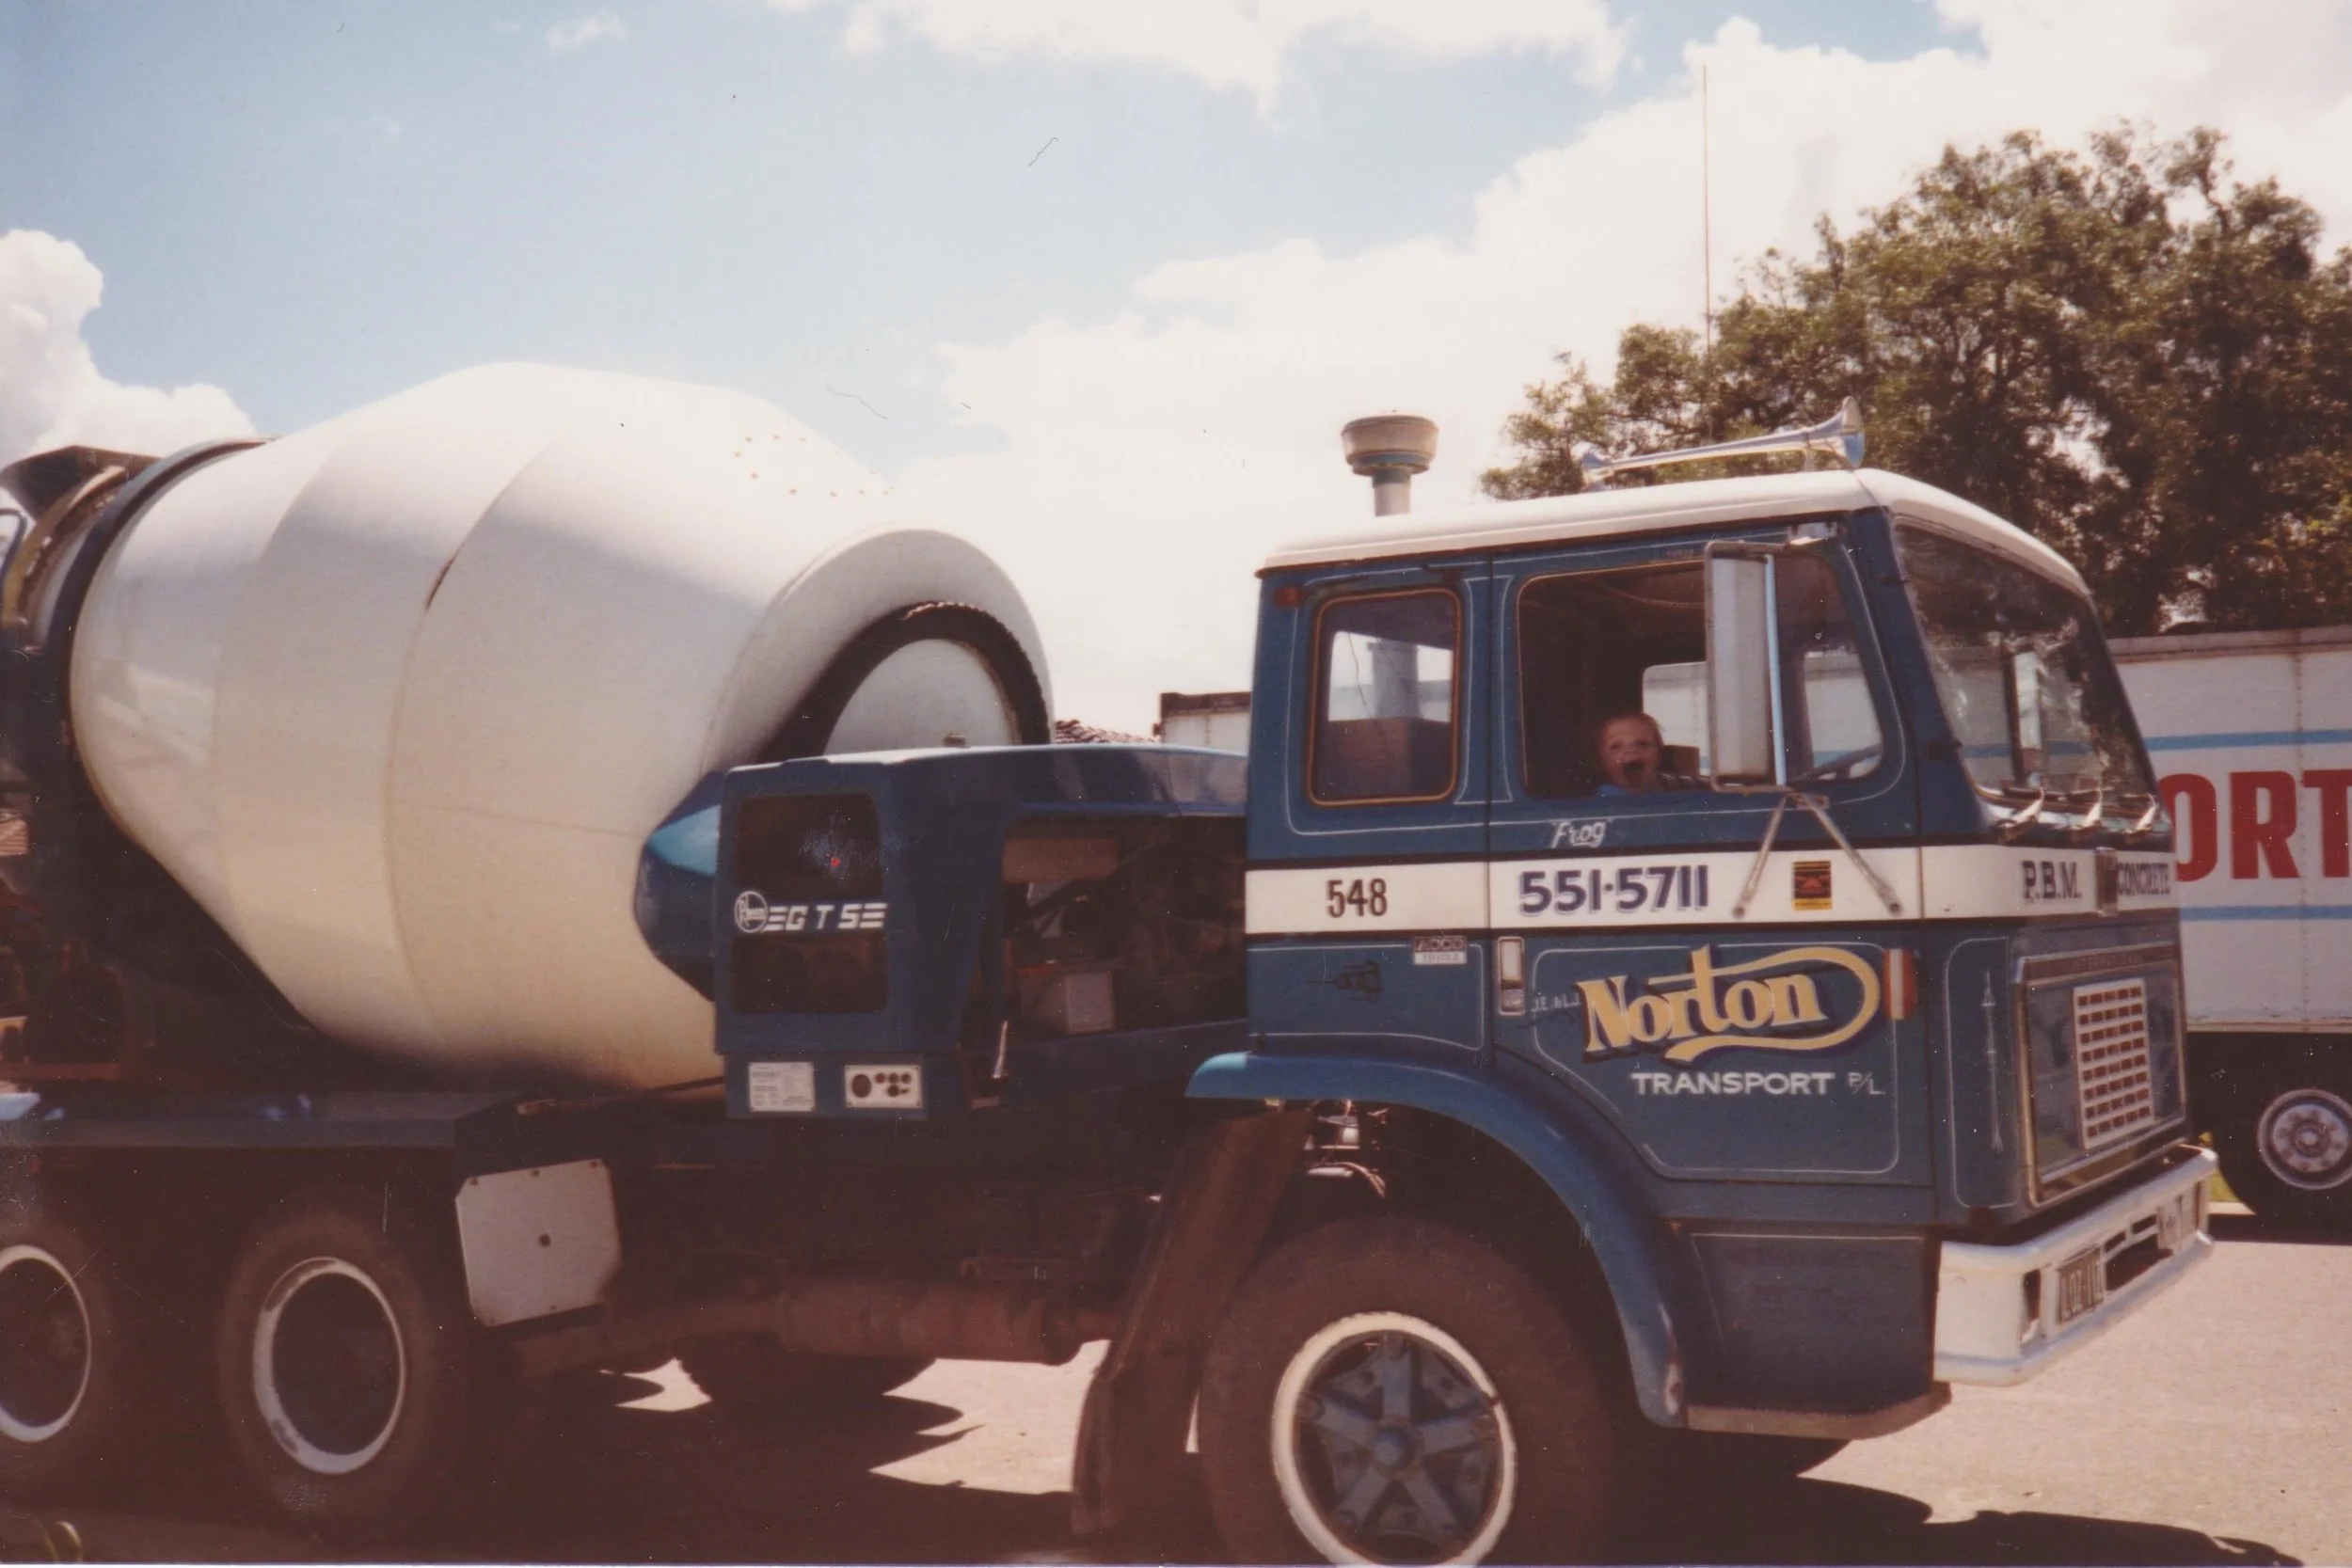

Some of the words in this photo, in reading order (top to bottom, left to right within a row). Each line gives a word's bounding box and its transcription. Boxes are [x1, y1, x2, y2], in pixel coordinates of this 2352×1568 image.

[1326, 878, 1388, 919] 548
[2022, 861, 2082, 900] P.B.M.
[2117, 863, 2170, 895] CONCRETE
[1576, 942, 1835, 1055] Norton
[1630, 1071, 1835, 1095] TRANSPORT
[1848, 1071, 1886, 1095] P/L
